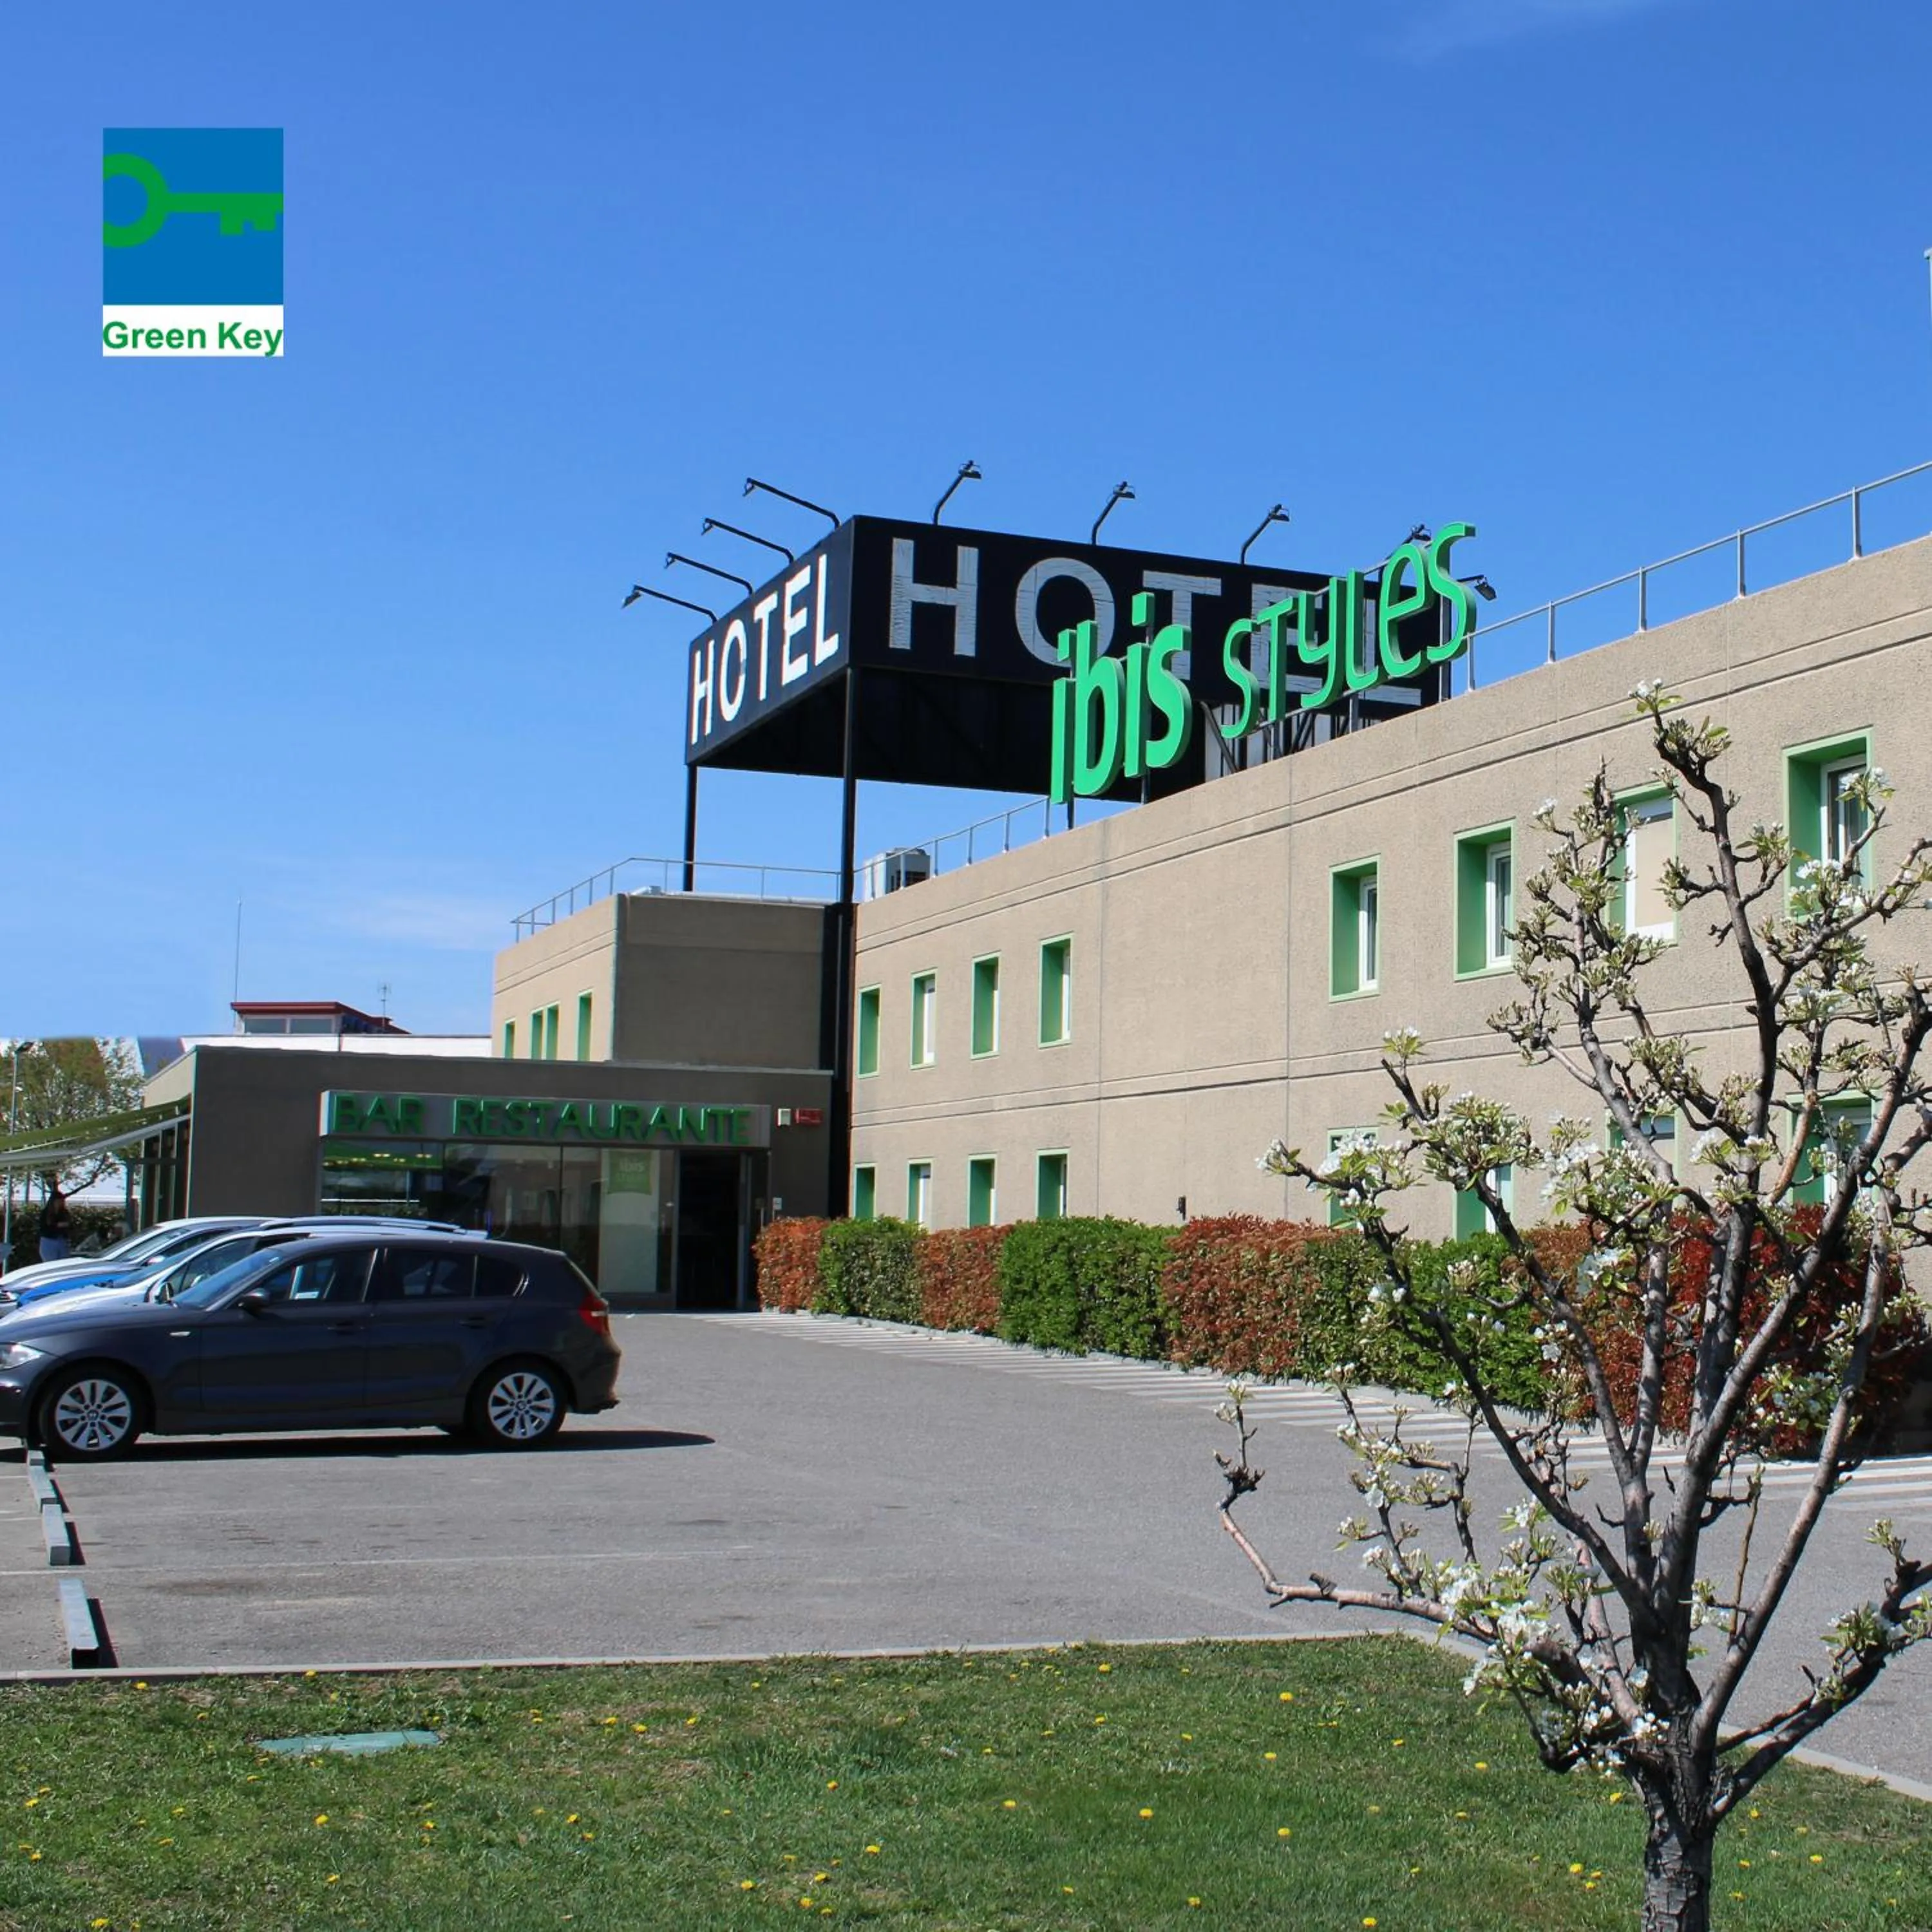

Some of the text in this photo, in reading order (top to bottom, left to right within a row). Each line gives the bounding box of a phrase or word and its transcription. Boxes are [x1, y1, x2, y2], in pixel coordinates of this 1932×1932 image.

[691, 554, 838, 745] HOTEL
[1051, 591, 1193, 804] ibis
[333, 1094, 752, 1144] BAR RESTAURANTE
